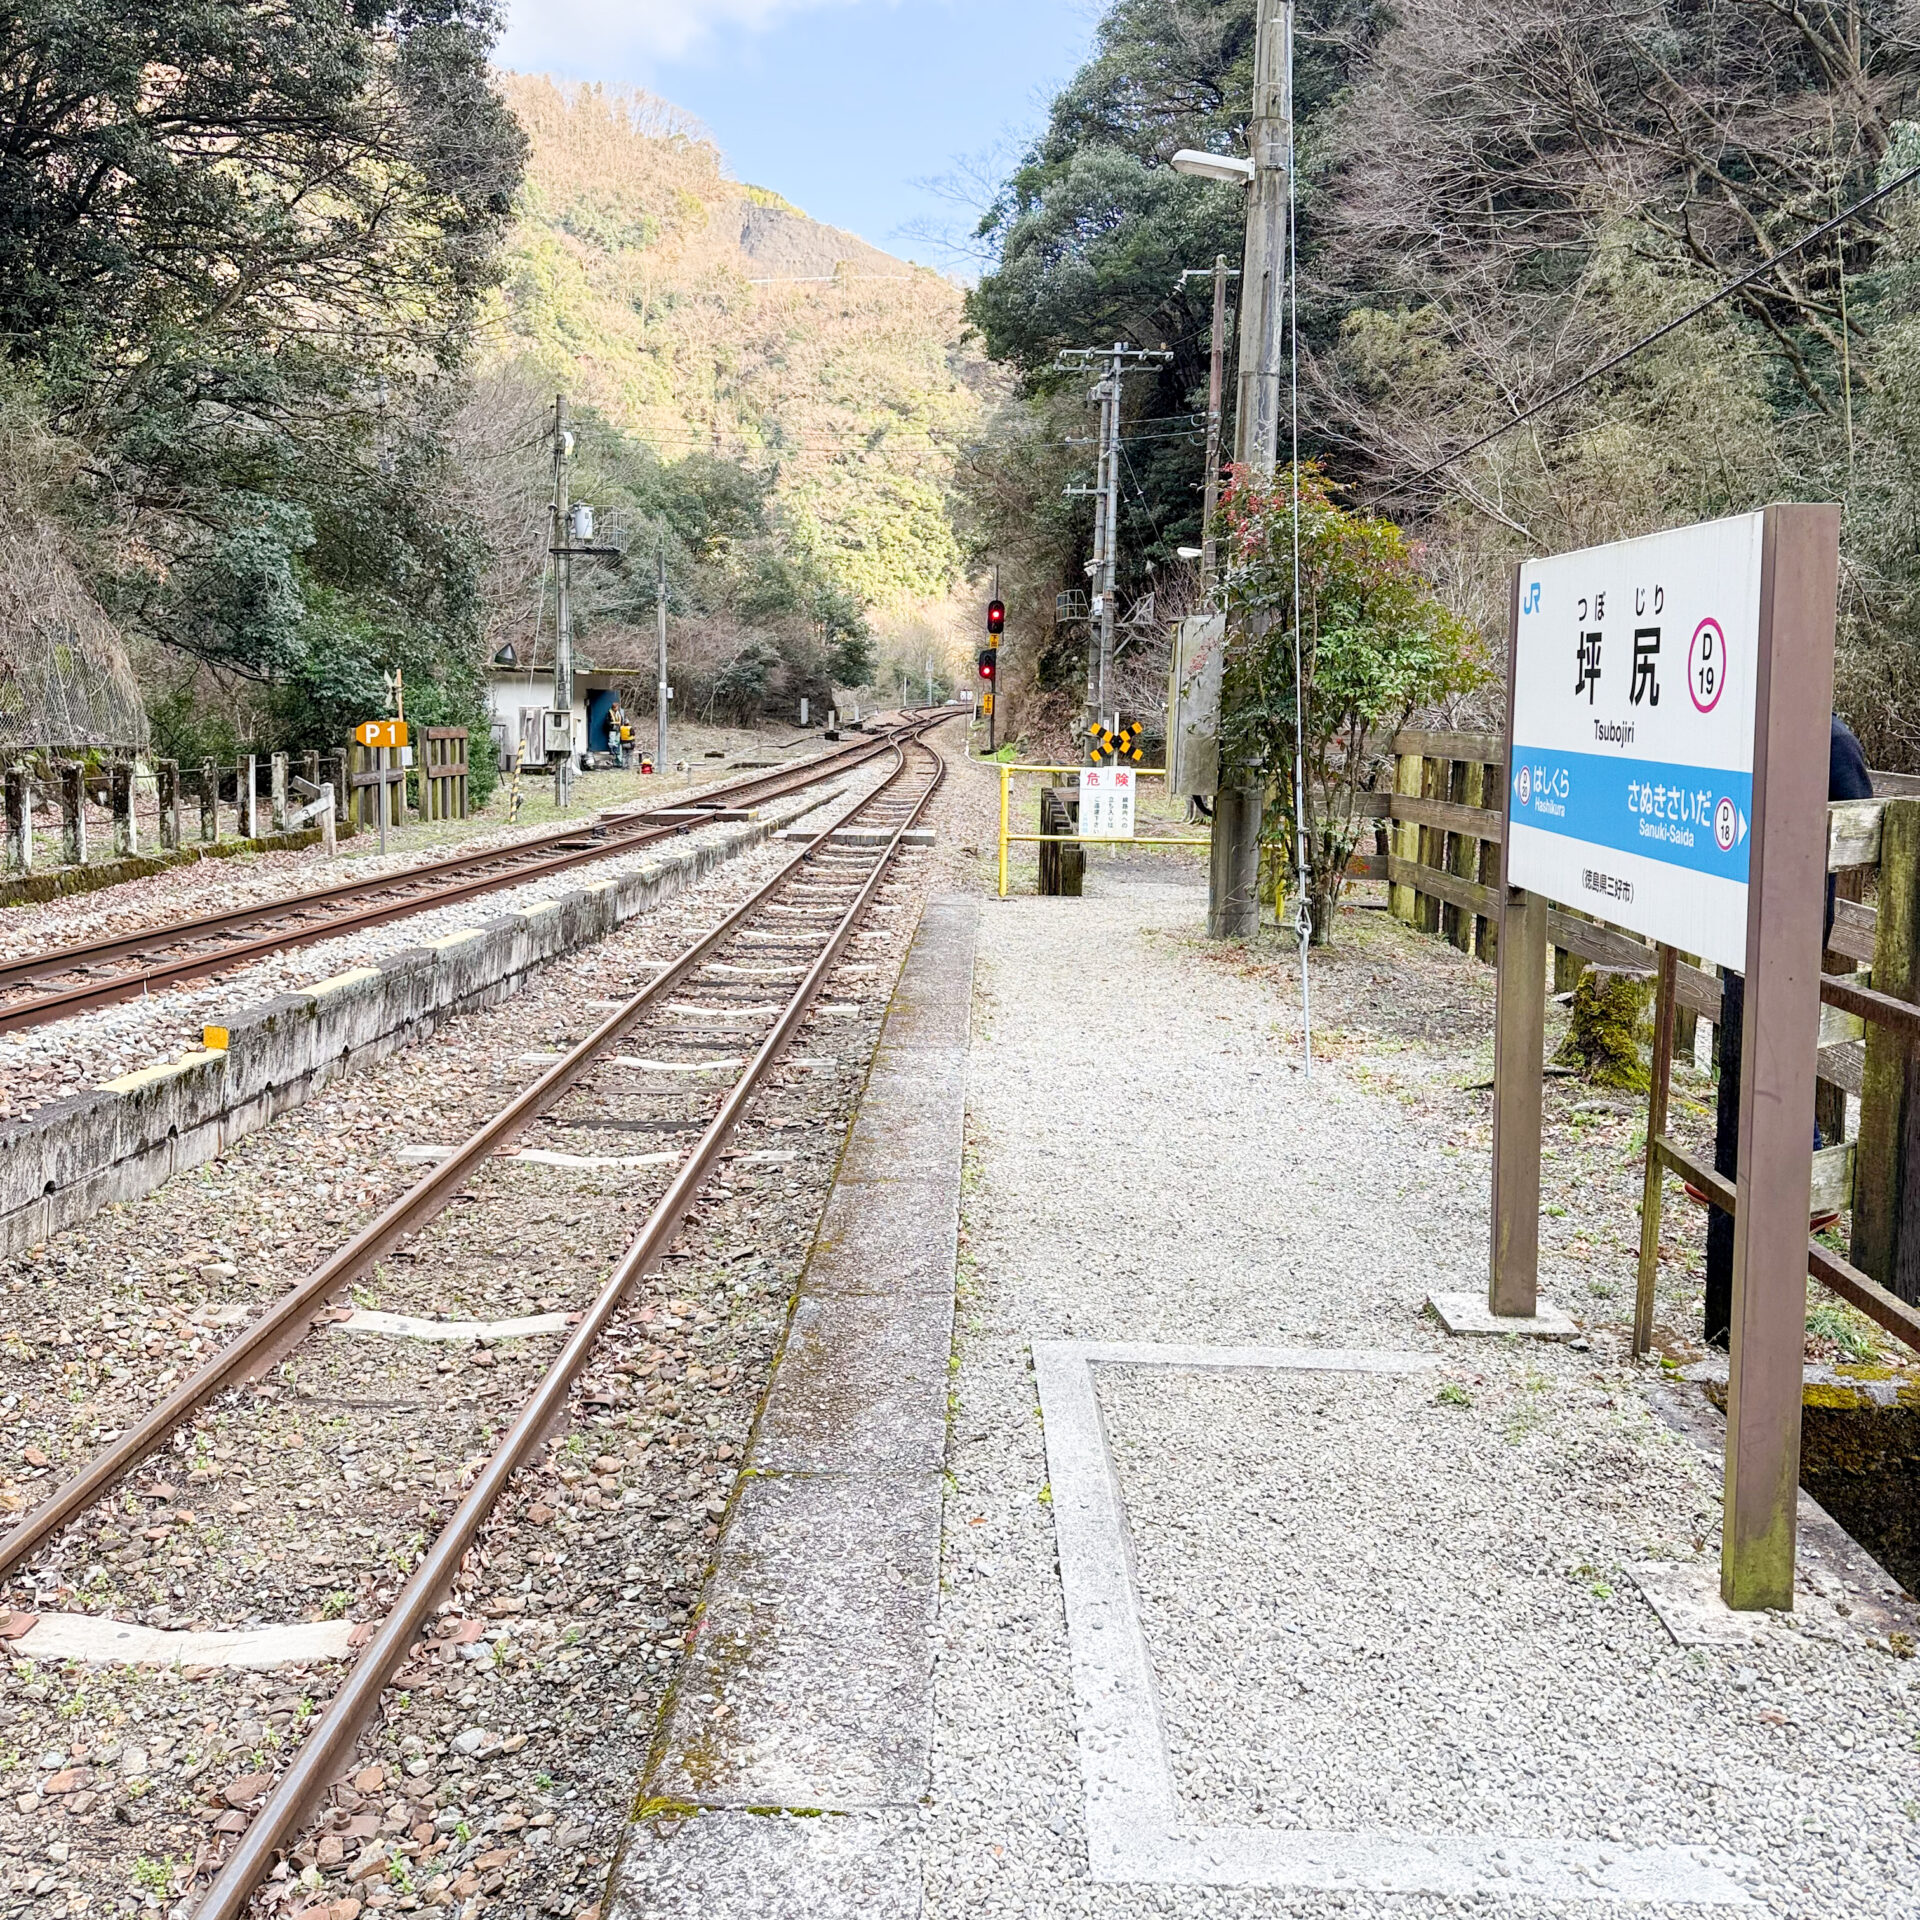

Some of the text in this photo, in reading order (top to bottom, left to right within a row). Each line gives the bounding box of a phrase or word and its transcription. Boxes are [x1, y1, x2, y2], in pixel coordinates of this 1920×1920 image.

[1524, 582, 1540, 614] JR
[1702, 633, 1712, 661] D
[1575, 627, 1661, 706] 坪尻
[1699, 667, 1714, 694] 19
[1594, 719, 1635, 748] Tsubojiri
[1087, 772, 1129, 787] 危険
[1533, 765, 1569, 798] はしくら
[1534, 796, 1566, 818] Hashikura
[1628, 779, 1712, 827] さぬきさいだ
[1722, 806, 1729, 822] D
[1639, 818, 1694, 848] Sanuki-Saida
[1720, 825, 1730, 841] 18
[1582, 868, 1634, 904] (徳島県三好市)
